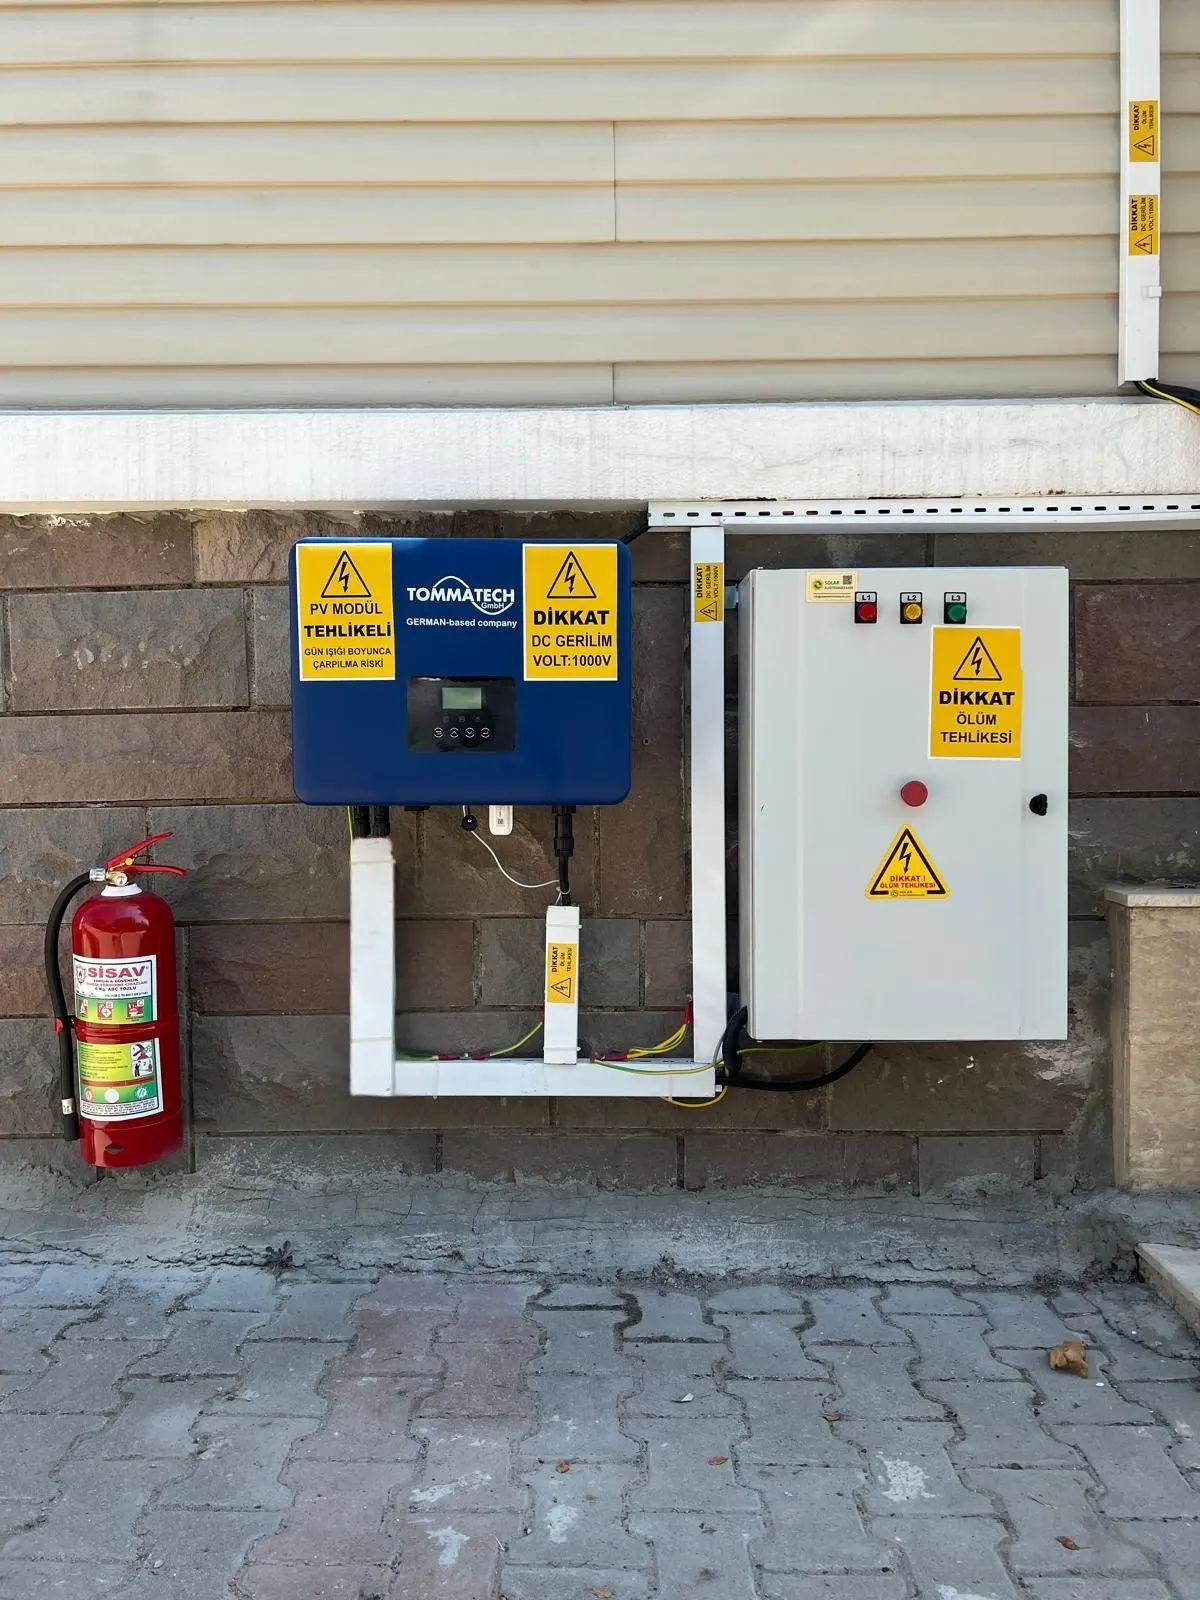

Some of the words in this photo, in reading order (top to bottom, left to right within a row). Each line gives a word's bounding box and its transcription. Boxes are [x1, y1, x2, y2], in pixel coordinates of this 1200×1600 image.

[406, 587, 514, 602] TOMMATECH
[310, 603, 328, 615] PV
[332, 600, 383, 614] MODÜL
[534, 607, 609, 625] DİKKAT
[304, 622, 391, 637] TEHLİKELİ
[406, 618, 476, 626] GERMAN-based
[478, 620, 517, 628] company
[532, 635, 551, 647] DC
[556, 632, 612, 647] GERİLİM
[304, 647, 323, 656] GÜN
[326, 647, 346, 657] IŞIĞI
[313, 660, 358, 670] ÇARPILMA
[360, 659, 383, 668] RİSKİ
[533, 655, 611, 666] VOLT:1000V
[939, 688, 1015, 705] DİKKAT
[957, 712, 996, 725] ÖLÜM
[940, 730, 1012, 743] TEHLİKESİ
[88, 966, 145, 978] SİSAV
